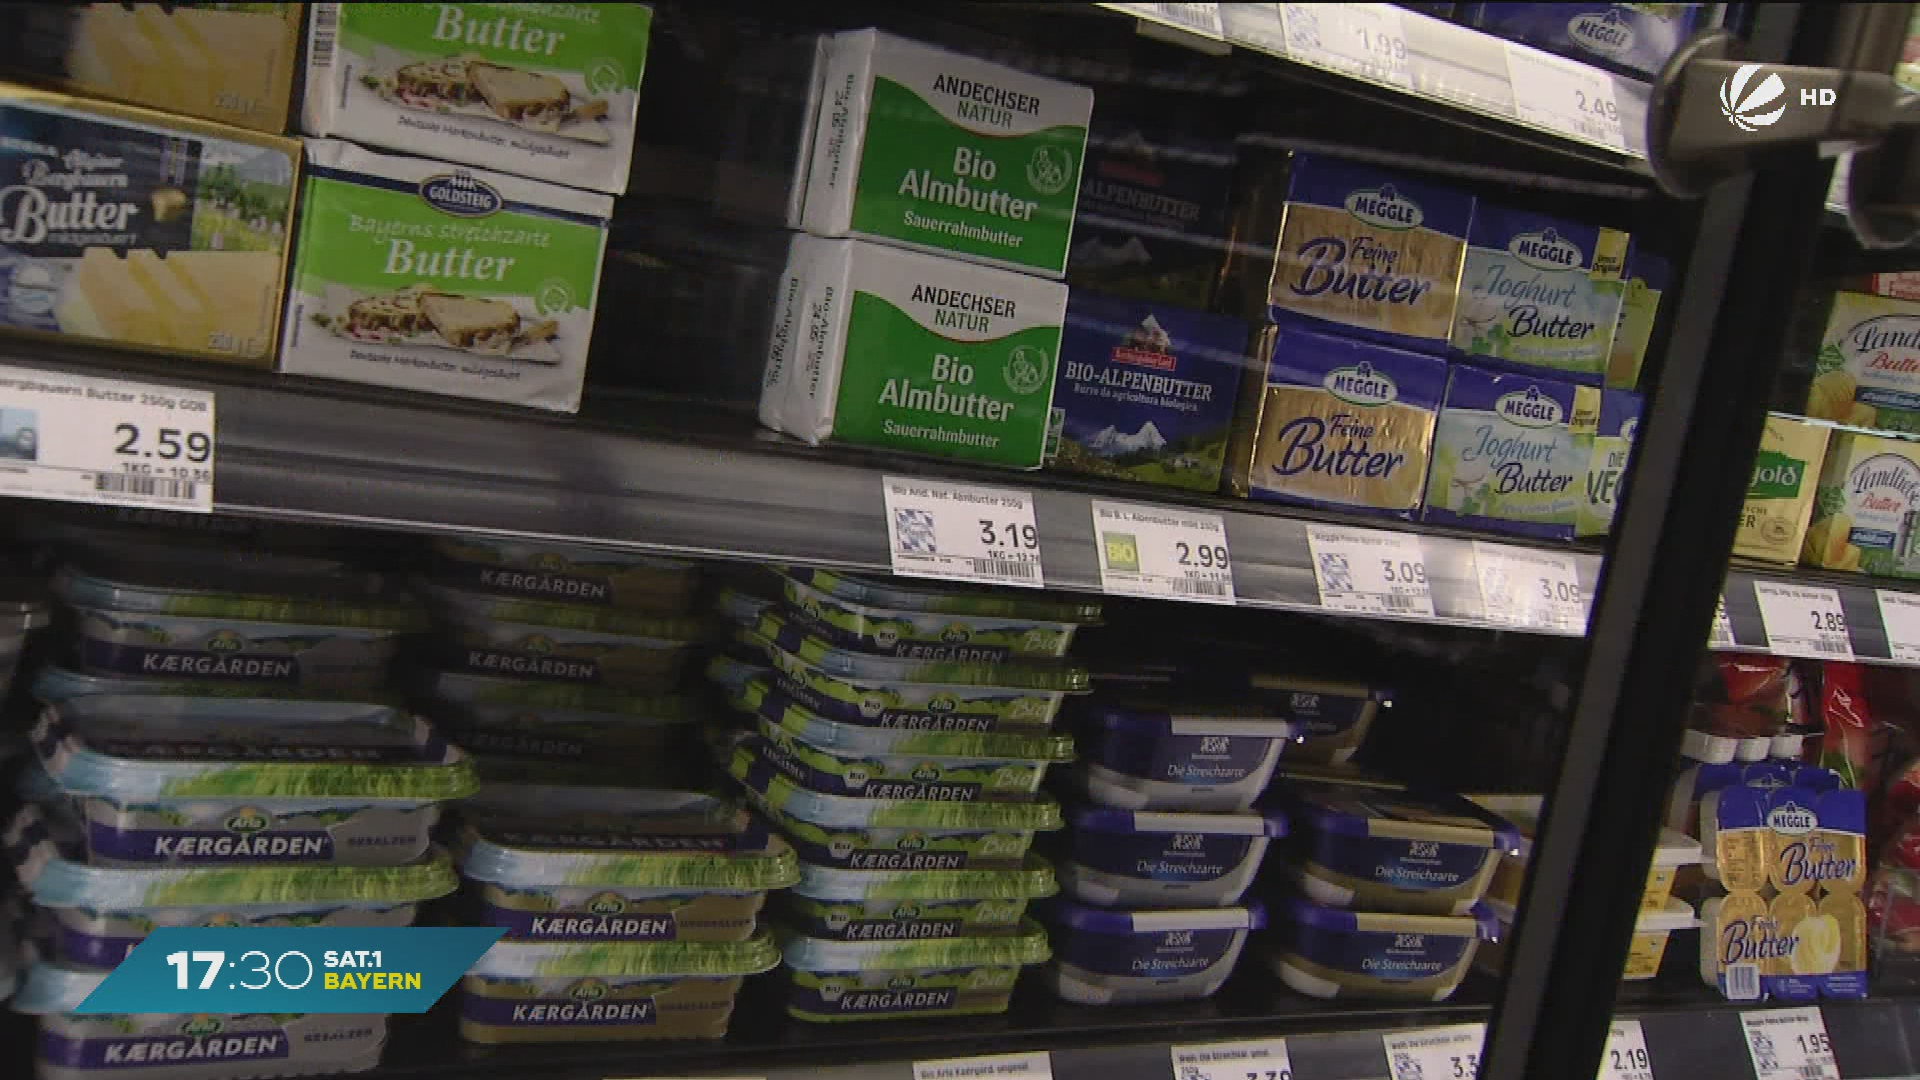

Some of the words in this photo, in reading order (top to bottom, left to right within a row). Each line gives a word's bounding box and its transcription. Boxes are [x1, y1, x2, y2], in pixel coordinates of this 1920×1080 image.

[433, 3, 566, 56] Butter
[1577, 19, 1628, 47] MEGGLE
[933, 73, 1040, 116] ANDECHSER
[1575, 89, 1618, 121] 2.49
[956, 101, 1012, 130] NATUR
[954, 146, 996, 182] Bio
[429, 186, 491, 208] GOLDSTEIG
[898, 169, 1038, 221] Almbutter
[0, 186, 139, 243] Butter
[1355, 197, 1413, 224] MEGGLE
[349, 215, 432, 244] Bayerns
[904, 211, 1023, 249] Sauerrahmbutter
[384, 239, 515, 282] Butter
[1351, 236, 1398, 265] Feine
[1518, 240, 1574, 265] MEGGLE
[1290, 237, 1432, 306] Butter
[1472, 264, 1577, 310] Joghurt
[911, 284, 1016, 319] ANDECHSER
[935, 309, 989, 332] NATUR
[1506, 305, 1595, 340] Butter
[931, 353, 975, 385] Bio
[1065, 361, 1213, 402] BIO-ALPENBUTTER
[87, 387, 135, 401] Butter
[1334, 375, 1388, 400] MEGGLE
[877, 379, 1015, 423] Almbutter
[1504, 400, 1555, 421] MEGGLE
[883, 419, 1000, 449] Sauerrahmbutter
[1330, 414, 1375, 439] Feine
[114, 423, 210, 463] 2.59
[1272, 416, 1404, 479] Butter
[1461, 424, 1557, 469] Joghurt
[122, 462, 151, 474] 1KG
[1494, 462, 1573, 495] Butter
[979, 519, 1038, 549] 3.19
[988, 549, 1007, 560] 1KG
[1106, 543, 1136, 563] BIO
[1176, 541, 1228, 570] 2.99
[480, 569, 607, 598] KÆRGÅRDEN
[1381, 558, 1426, 583] 3.09
[1539, 577, 1580, 603] 3.09
[1811, 610, 1846, 632] 2.89
[945, 631, 965, 642] Arla
[143, 652, 293, 678] KÆRGÅRDEN
[469, 652, 594, 679] KÆRGÅRDEN
[896, 643, 1002, 666] KÆRGÅRDEN
[931, 701, 952, 711] Arla
[881, 712, 988, 732] KÆRGÅRDEN
[915, 769, 936, 779] Arla
[1168, 764, 1184, 778] Die
[1185, 761, 1246, 778] Streichzarte
[864, 782, 974, 800] KÆRGÅRDEN
[232, 818, 261, 829] Arla
[1773, 814, 1810, 828] MEGGLE
[155, 831, 322, 857] KÆRGÅRDEN
[900, 839, 922, 850] Arla
[851, 851, 960, 869] KÆRGÅRDEN
[1137, 860, 1157, 874] Die
[1158, 860, 1223, 876] Streichzarte
[1375, 865, 1393, 877] Die
[1394, 865, 1459, 881] Streichzarte
[1780, 842, 1855, 886] Butter
[593, 903, 618, 913] Arla
[532, 916, 669, 937] KÆRGÅRDEN
[847, 918, 954, 939] KÆRGÅRDEN
[1722, 919, 1800, 965] Butter
[1132, 957, 1150, 971] Die
[1151, 956, 1209, 971] Streichzarte
[1361, 958, 1381, 971] Die
[1382, 958, 1443, 971] Streichzarte
[513, 1002, 650, 1022] KÆRGÅRDEN
[841, 991, 949, 1010] KÆRGÅRDEN
[104, 1034, 278, 1064] KÆRGÅRDEN
[1794, 1033, 1829, 1054] 1.95
[1610, 1049, 1648, 1071] 2.19
